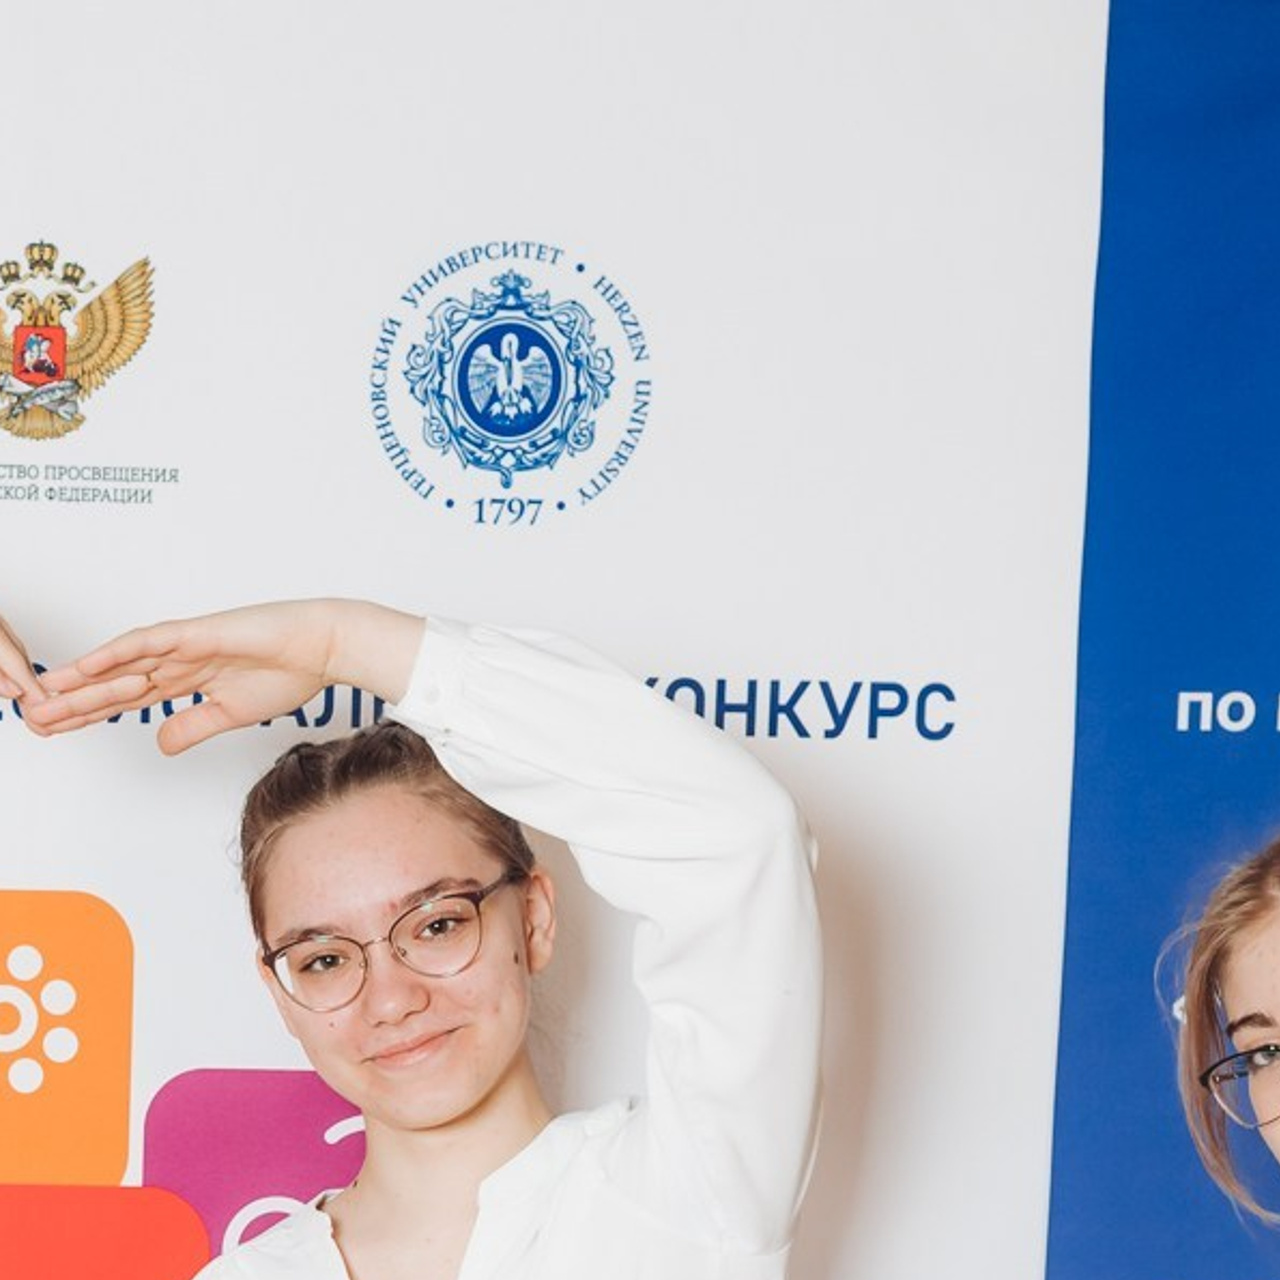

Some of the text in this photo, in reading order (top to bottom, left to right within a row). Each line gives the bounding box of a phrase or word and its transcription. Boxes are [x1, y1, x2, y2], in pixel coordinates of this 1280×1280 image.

[401, 241, 565, 308] УНИВЕРСИТЕТ
[592, 275, 651, 362] HERZEN
[370, 316, 435, 500] ГЕРЦЕНОВСКИЙ
[44, 465, 180, 483] ПРОСВЕЩЕНИЯ
[577, 379, 651, 506] UNIVERSITY
[44, 486, 153, 504] ФЕДЕРАЦИИ
[473, 497, 544, 526] 1797
[644, 676, 957, 741] ОНКУРС
[1177, 691, 1256, 732] по
